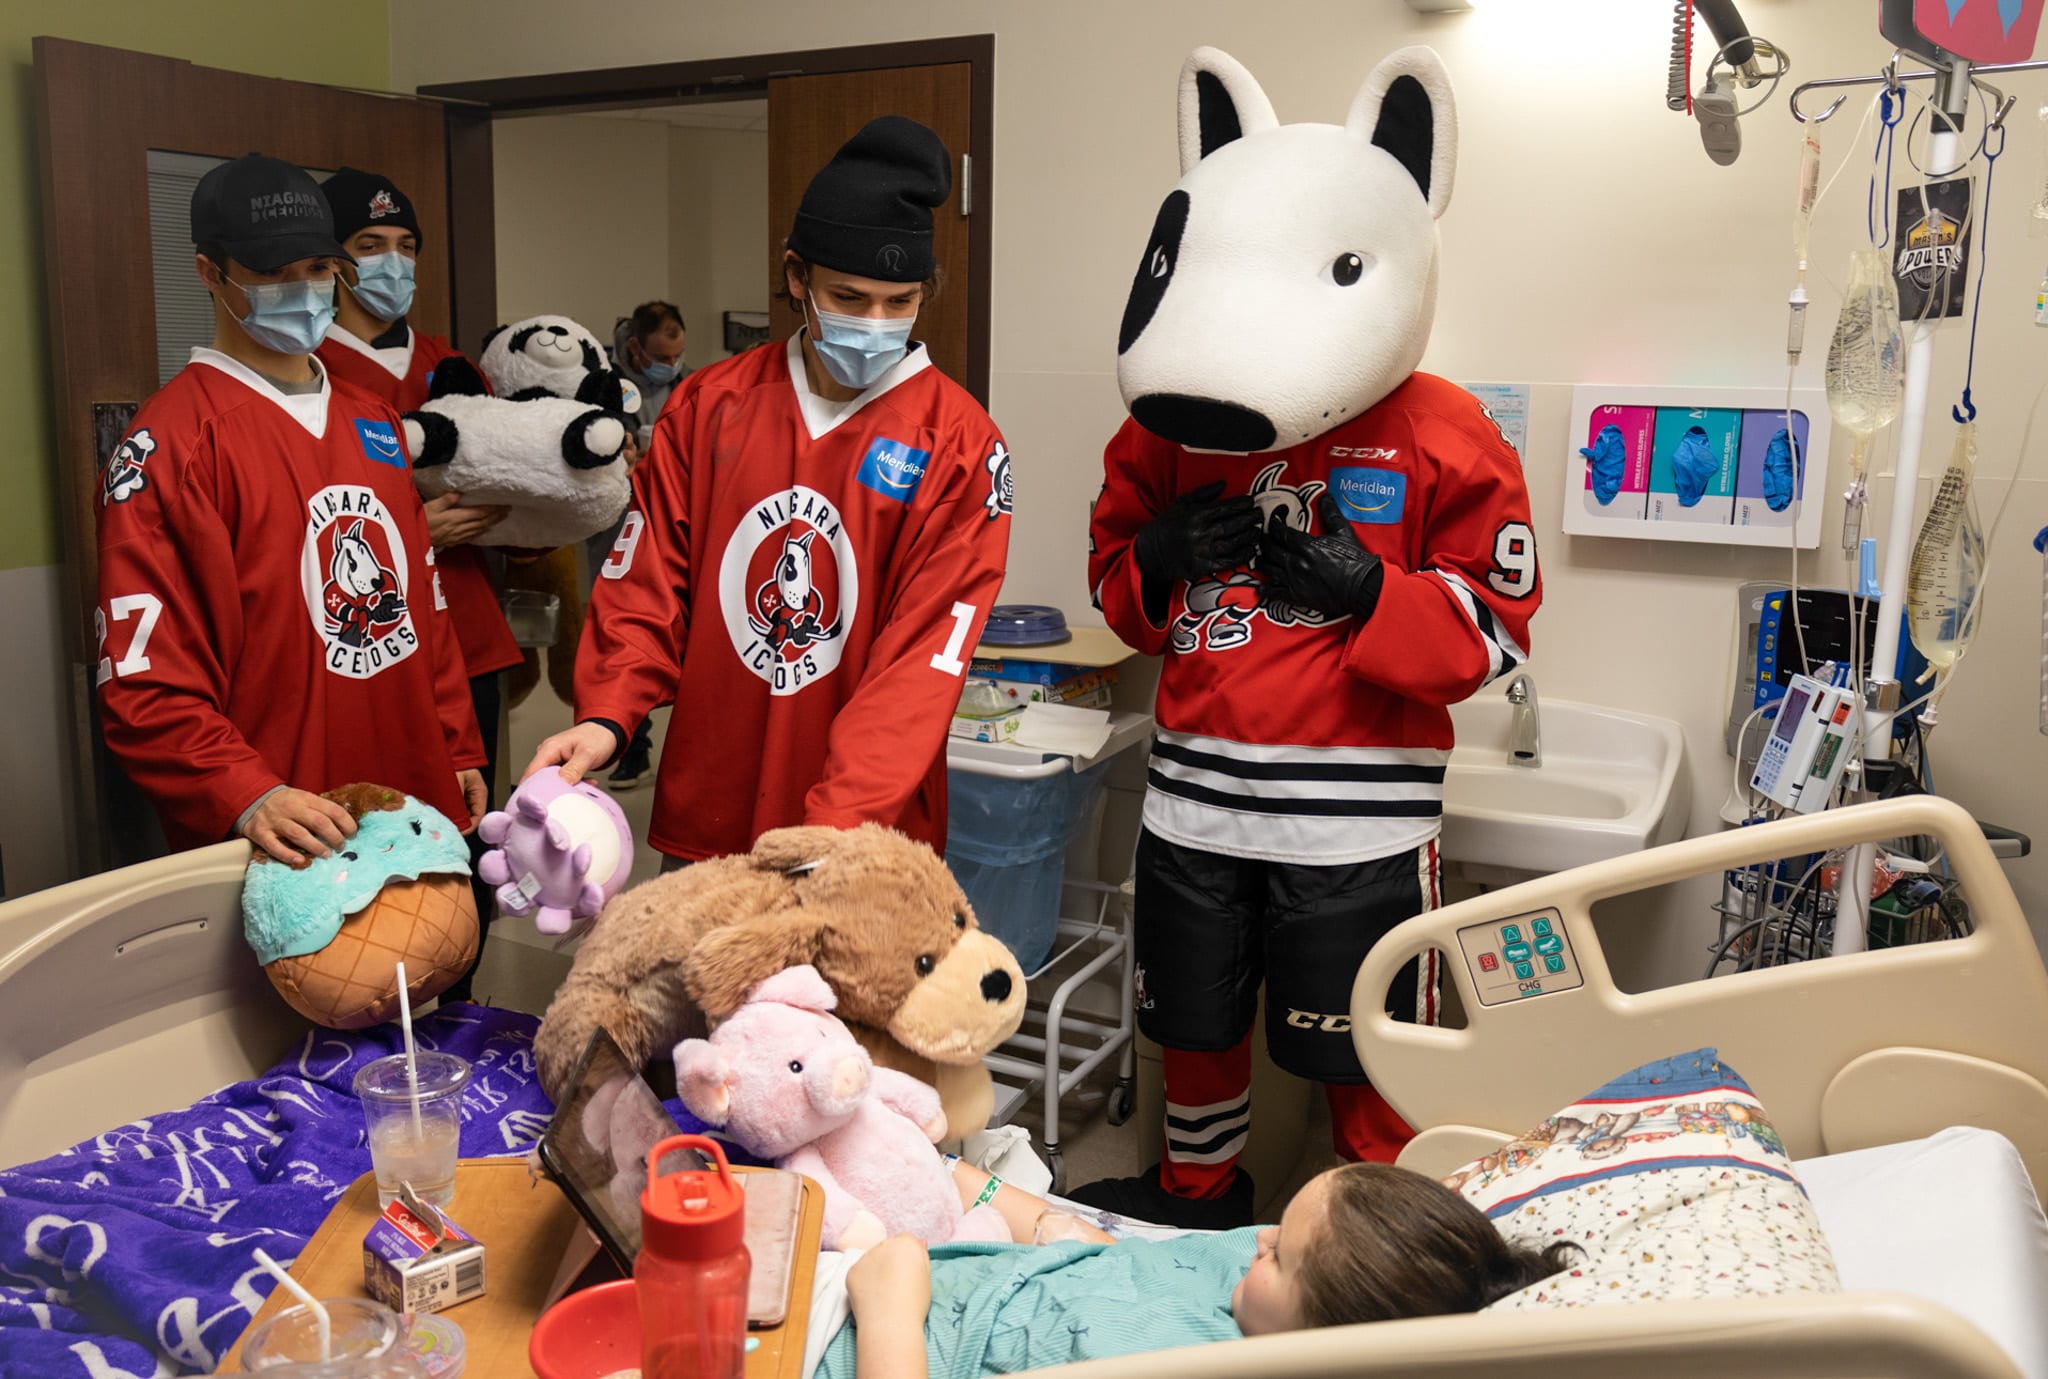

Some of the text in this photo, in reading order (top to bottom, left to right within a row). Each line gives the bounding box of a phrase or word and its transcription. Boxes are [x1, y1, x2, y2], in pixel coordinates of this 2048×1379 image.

[250, 191, 320, 210] NIAGARA
[1329, 446, 1398, 460] CCM
[876, 450, 925, 479] Meridian
[1339, 478, 1396, 497] Meridian
[1487, 521, 1537, 599] 9
[929, 600, 977, 677] 1
[1518, 980, 1541, 992] CHG
[1286, 1007, 1352, 1033] CC
